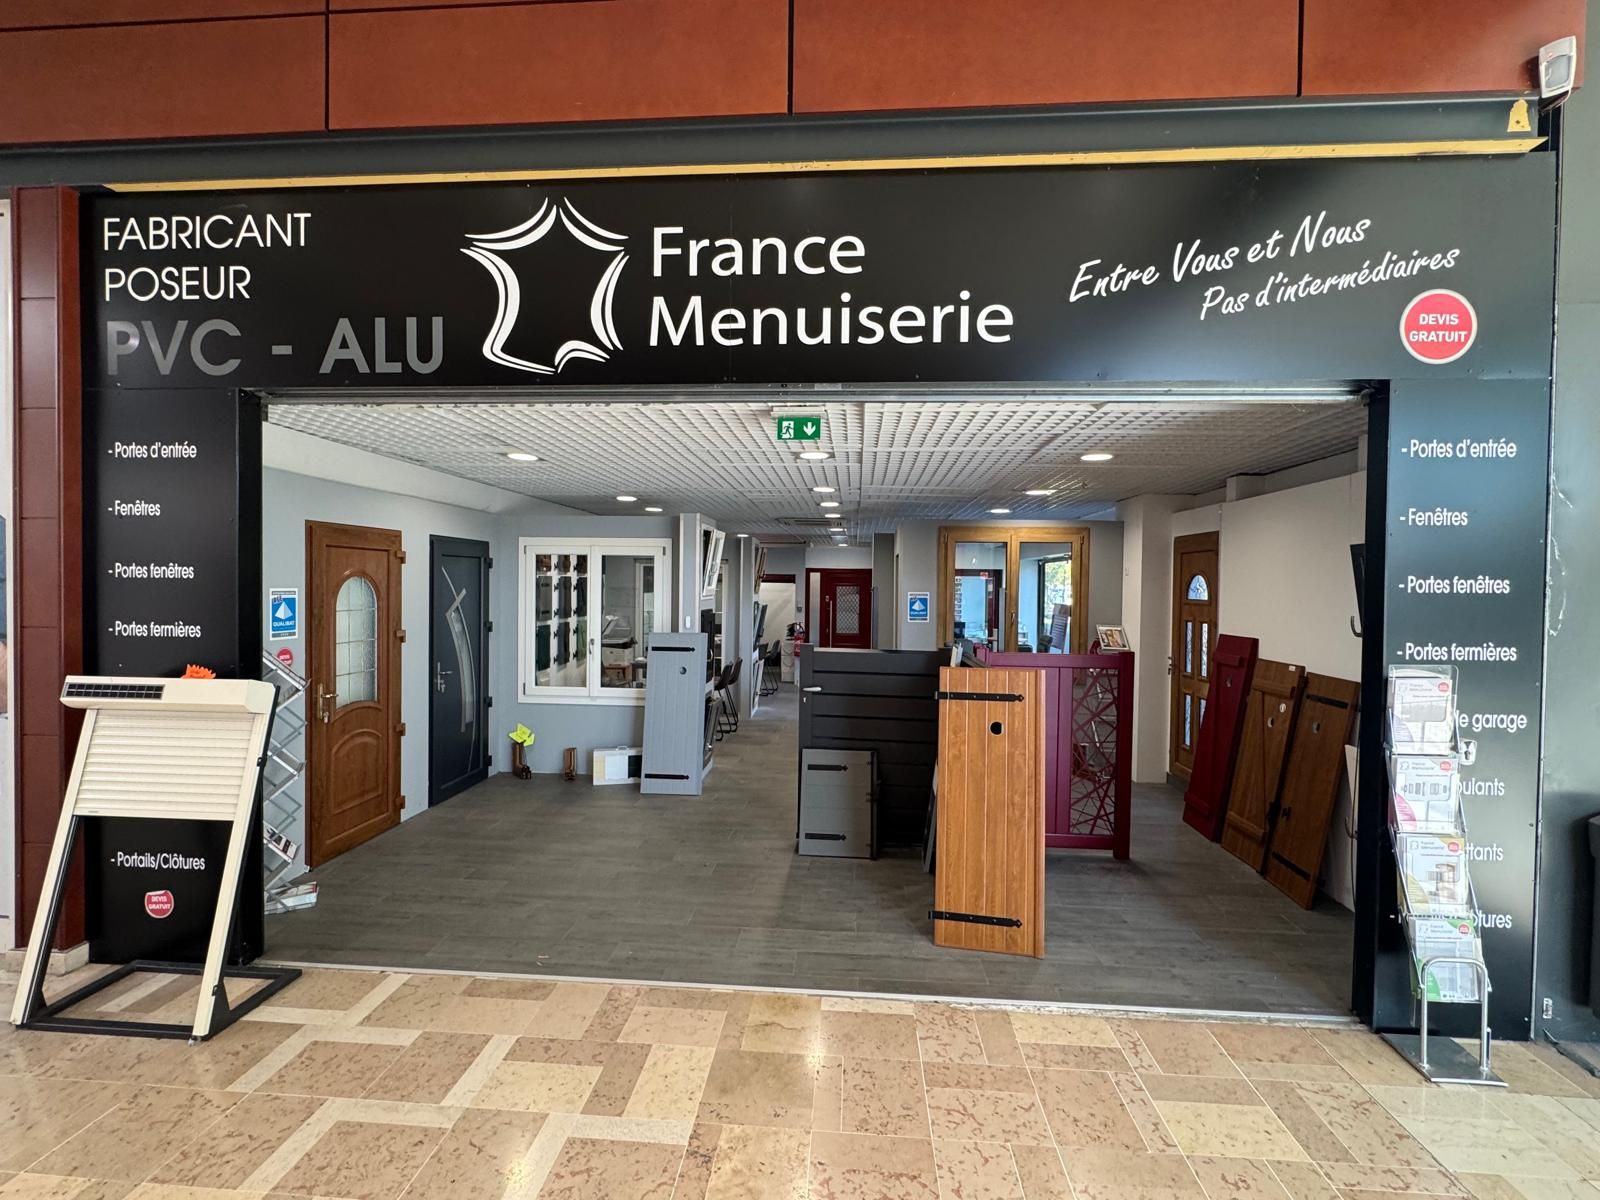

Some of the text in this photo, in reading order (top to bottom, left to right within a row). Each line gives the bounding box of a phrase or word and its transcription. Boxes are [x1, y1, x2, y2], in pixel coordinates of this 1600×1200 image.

[103, 212, 312, 251] FABRICANT
[653, 226, 866, 277] France
[1069, 210, 1372, 303] Entre Vous et Nous
[104, 265, 251, 302] POSEUR
[1199, 248, 1461, 321] Pas d'intermédiaires
[649, 289, 1014, 347] Menuiserie
[1419, 313, 1459, 326] DEVIS
[106, 316, 444, 376] PVC - ALU
[1409, 330, 1468, 344] GRATUIT
[150, 440, 197, 459] d'entrée
[1455, 437, 1517, 458] d'entrée
[150, 562, 195, 580] fenêtres
[1452, 574, 1511, 594] fenêtres
[150, 620, 202, 639] fermières
[1450, 641, 1518, 662] fermières
[1472, 713, 1528, 734] garage
